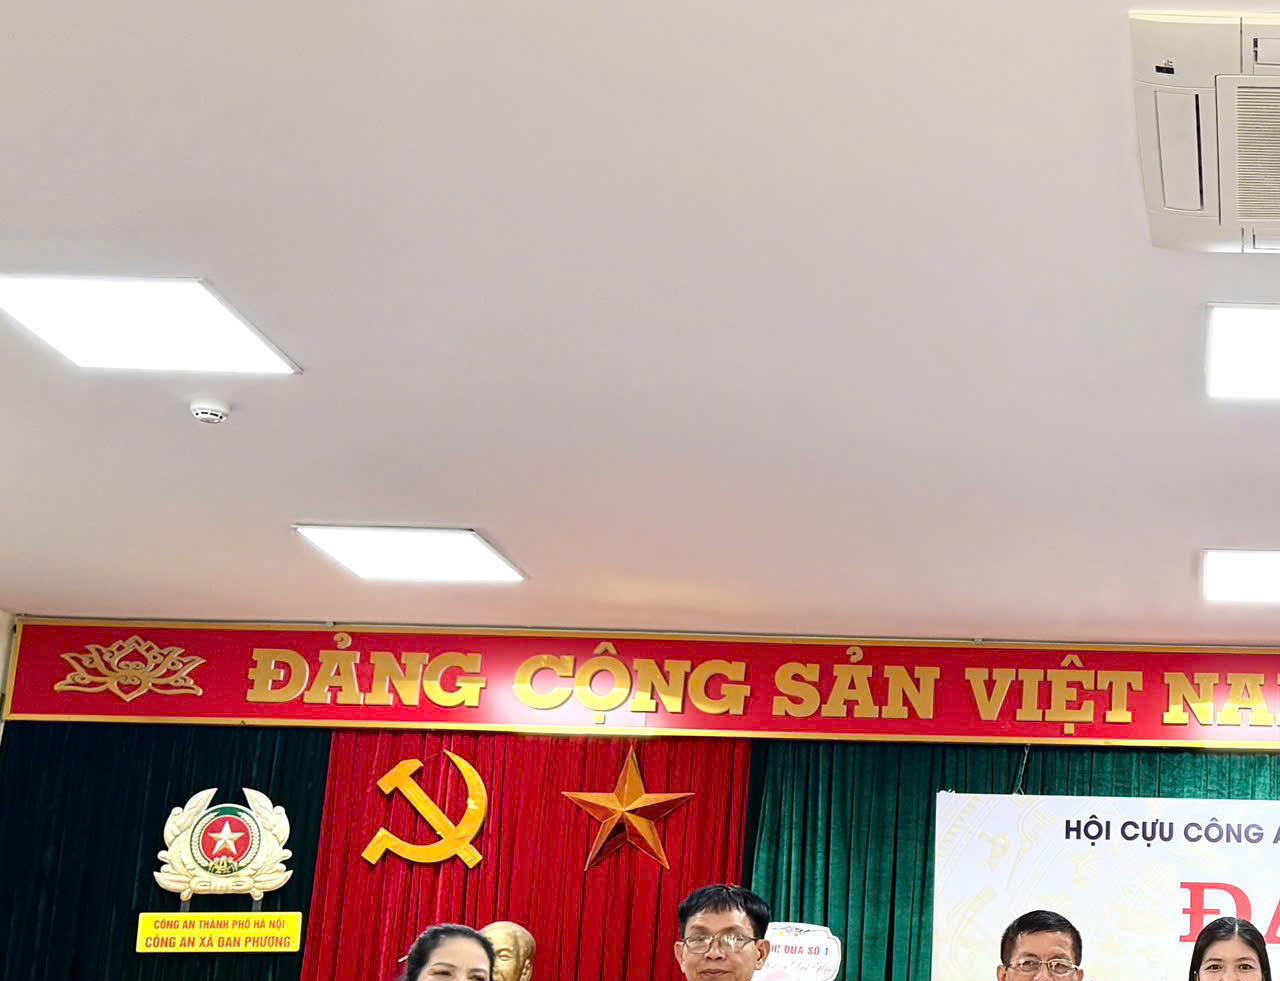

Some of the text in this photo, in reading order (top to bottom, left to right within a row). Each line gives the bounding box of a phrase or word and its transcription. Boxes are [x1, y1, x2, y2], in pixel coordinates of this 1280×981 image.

[247, 633, 486, 707] ĐẢNG
[514, 641, 751, 724] CỘNG
[772, 646, 940, 720] SẢN
[965, 654, 1143, 735] VIỆT
[1065, 814, 1111, 846] HỘI
[1120, 818, 1174, 847] CỰU
[1183, 817, 1264, 844] CÔNG
[154, 918, 179, 929] CÔNG
[182, 920, 196, 928] AN
[199, 918, 229, 928] THÀNH
[253, 918, 266, 928] HÀ
[269, 918, 285, 931] NỘI
[145, 934, 291, 949] CÔNG AN XÃ ĐAN PHƯỢNG
[825, 948, 829, 956] 1
